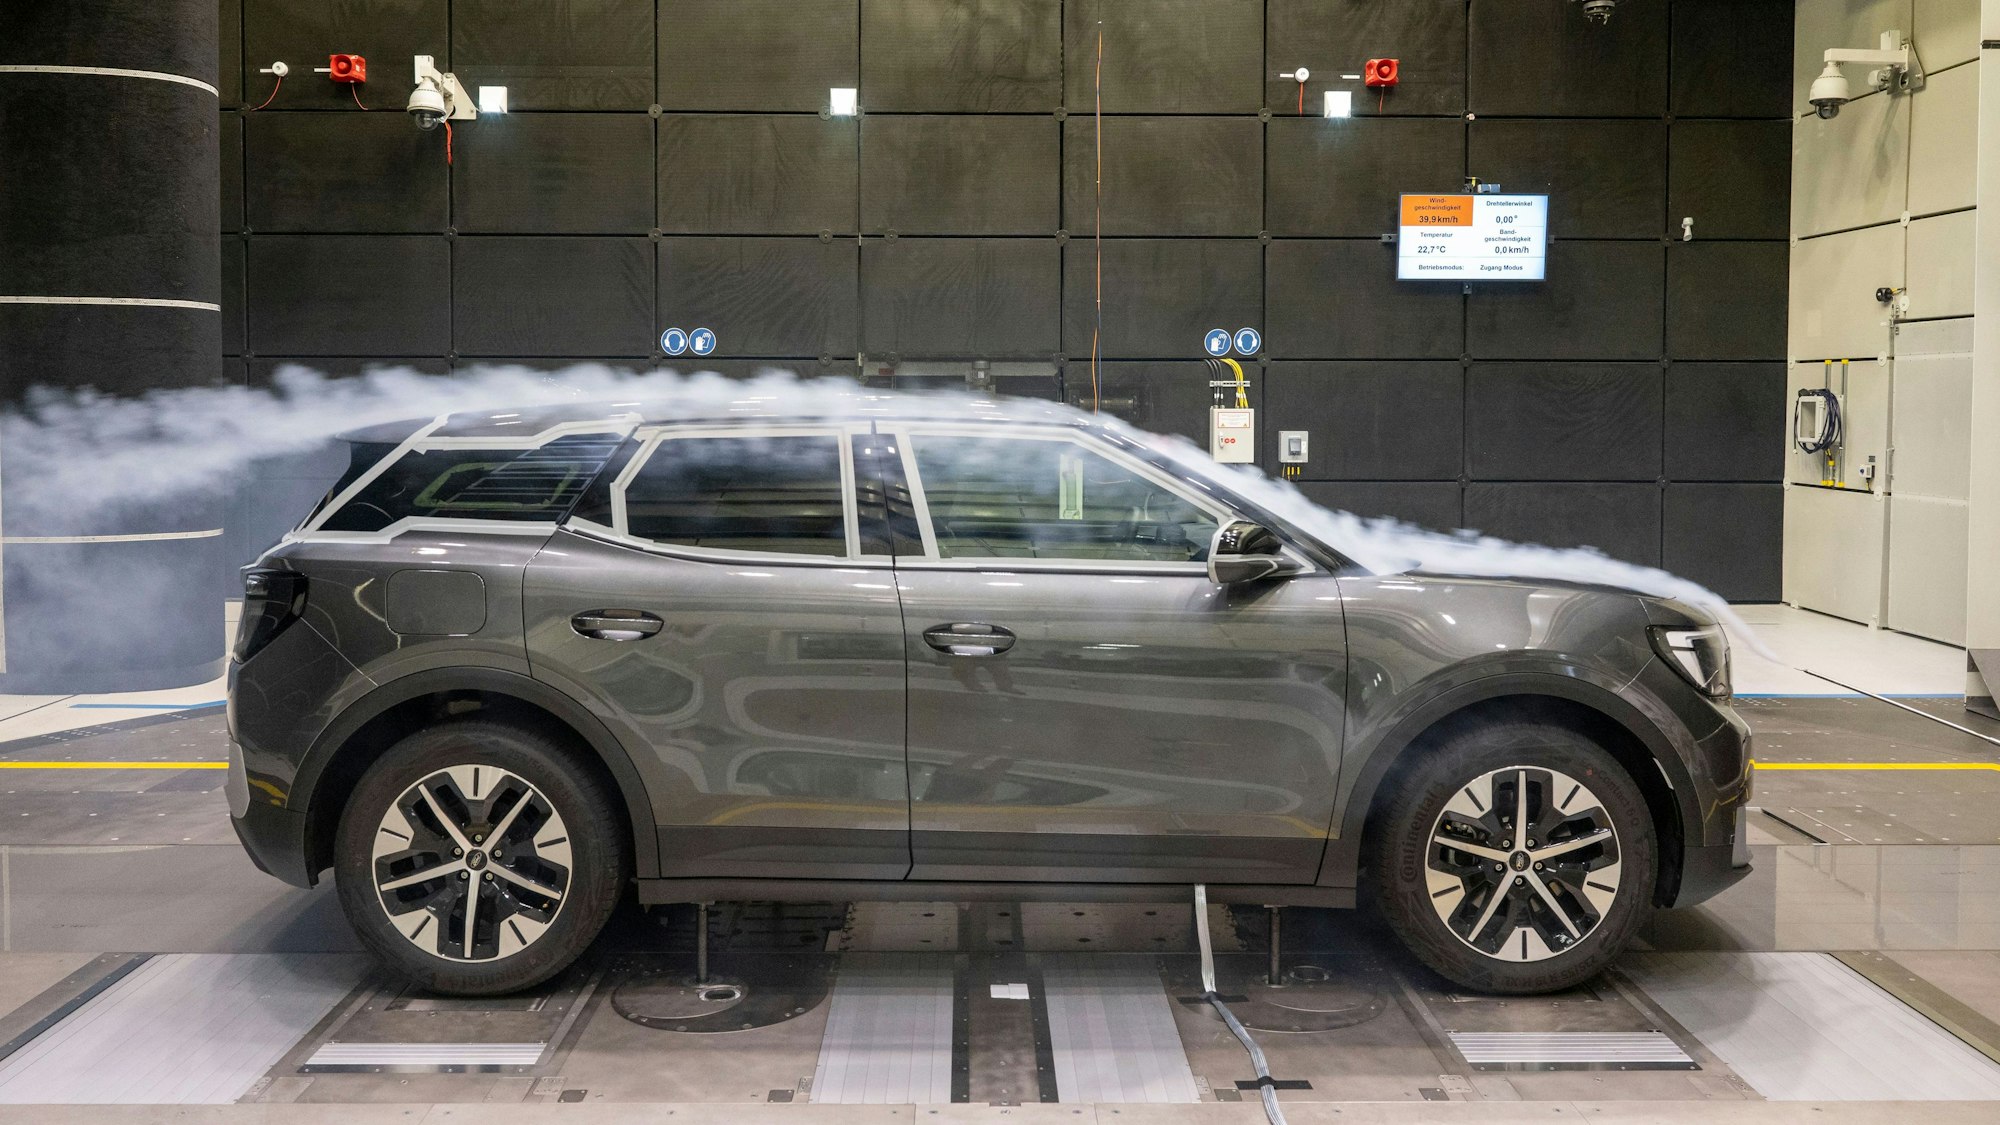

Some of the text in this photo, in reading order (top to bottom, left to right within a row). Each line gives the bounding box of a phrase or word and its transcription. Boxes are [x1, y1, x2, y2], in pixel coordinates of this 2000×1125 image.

[1508, 246, 1529, 254] km/h
[1480, 264, 1502, 272] Zugang
[1400, 789, 1440, 883] Continental
